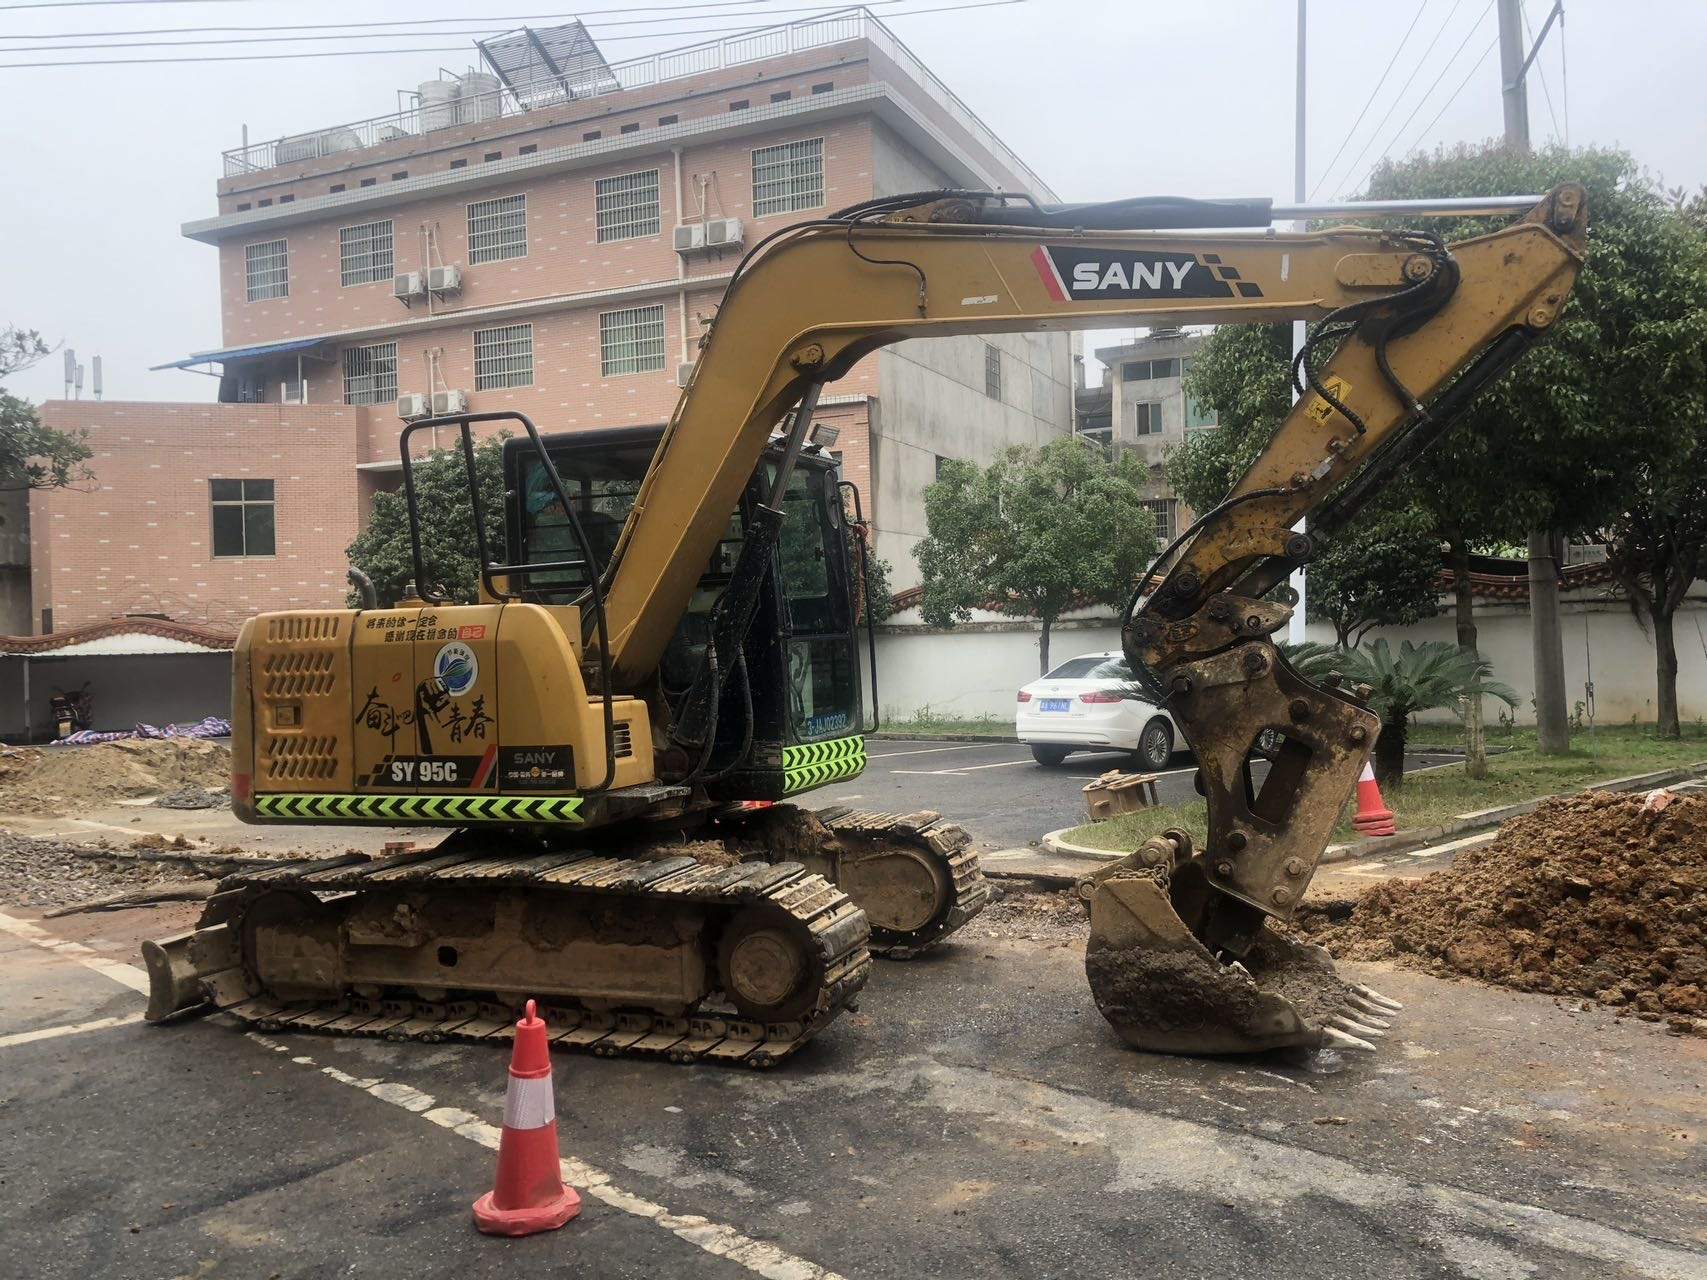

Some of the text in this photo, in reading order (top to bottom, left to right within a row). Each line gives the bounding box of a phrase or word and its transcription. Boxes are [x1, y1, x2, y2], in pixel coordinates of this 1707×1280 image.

[1072, 261, 1195, 290] SANY
[513, 752, 556, 764] SANY
[391, 761, 457, 782] SY 95C
